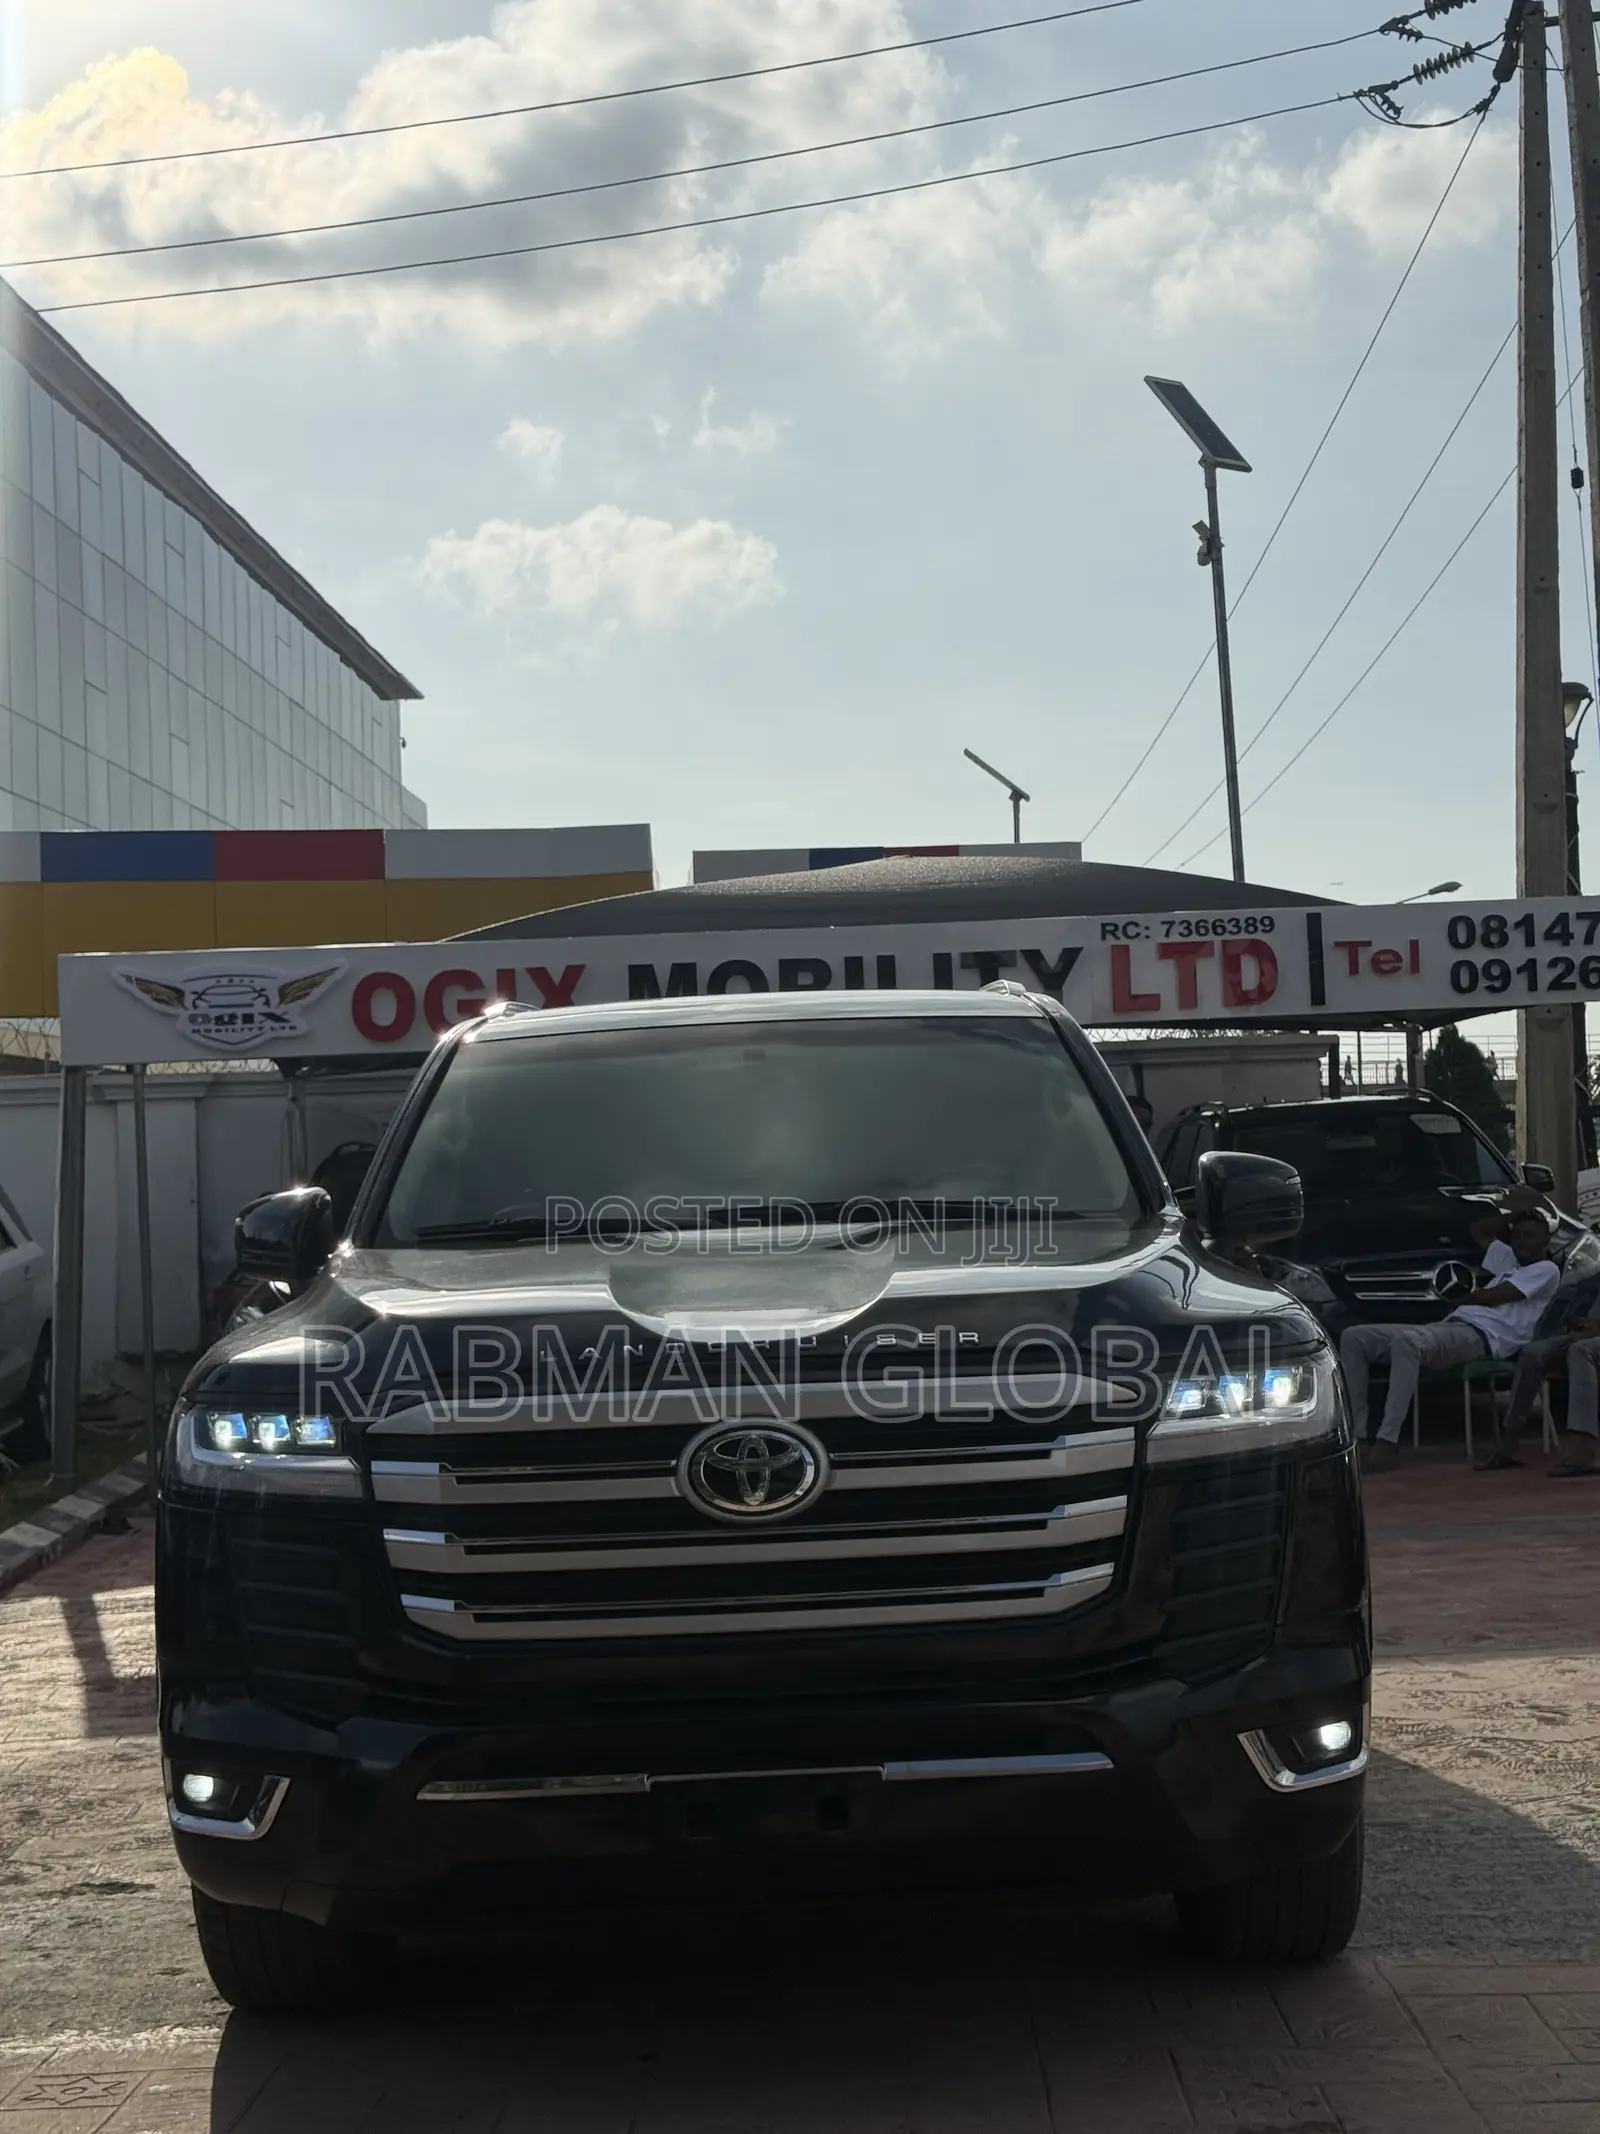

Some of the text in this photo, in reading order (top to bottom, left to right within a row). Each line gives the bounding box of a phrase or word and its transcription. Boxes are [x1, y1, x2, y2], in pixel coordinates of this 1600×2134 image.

[1100, 915, 1276, 941] RC: 7366389
[1448, 911, 1600, 950] 08147
[1111, 939, 1279, 1014] LTD
[1333, 939, 1421, 976] Tel
[1450, 955, 1600, 994] 09126
